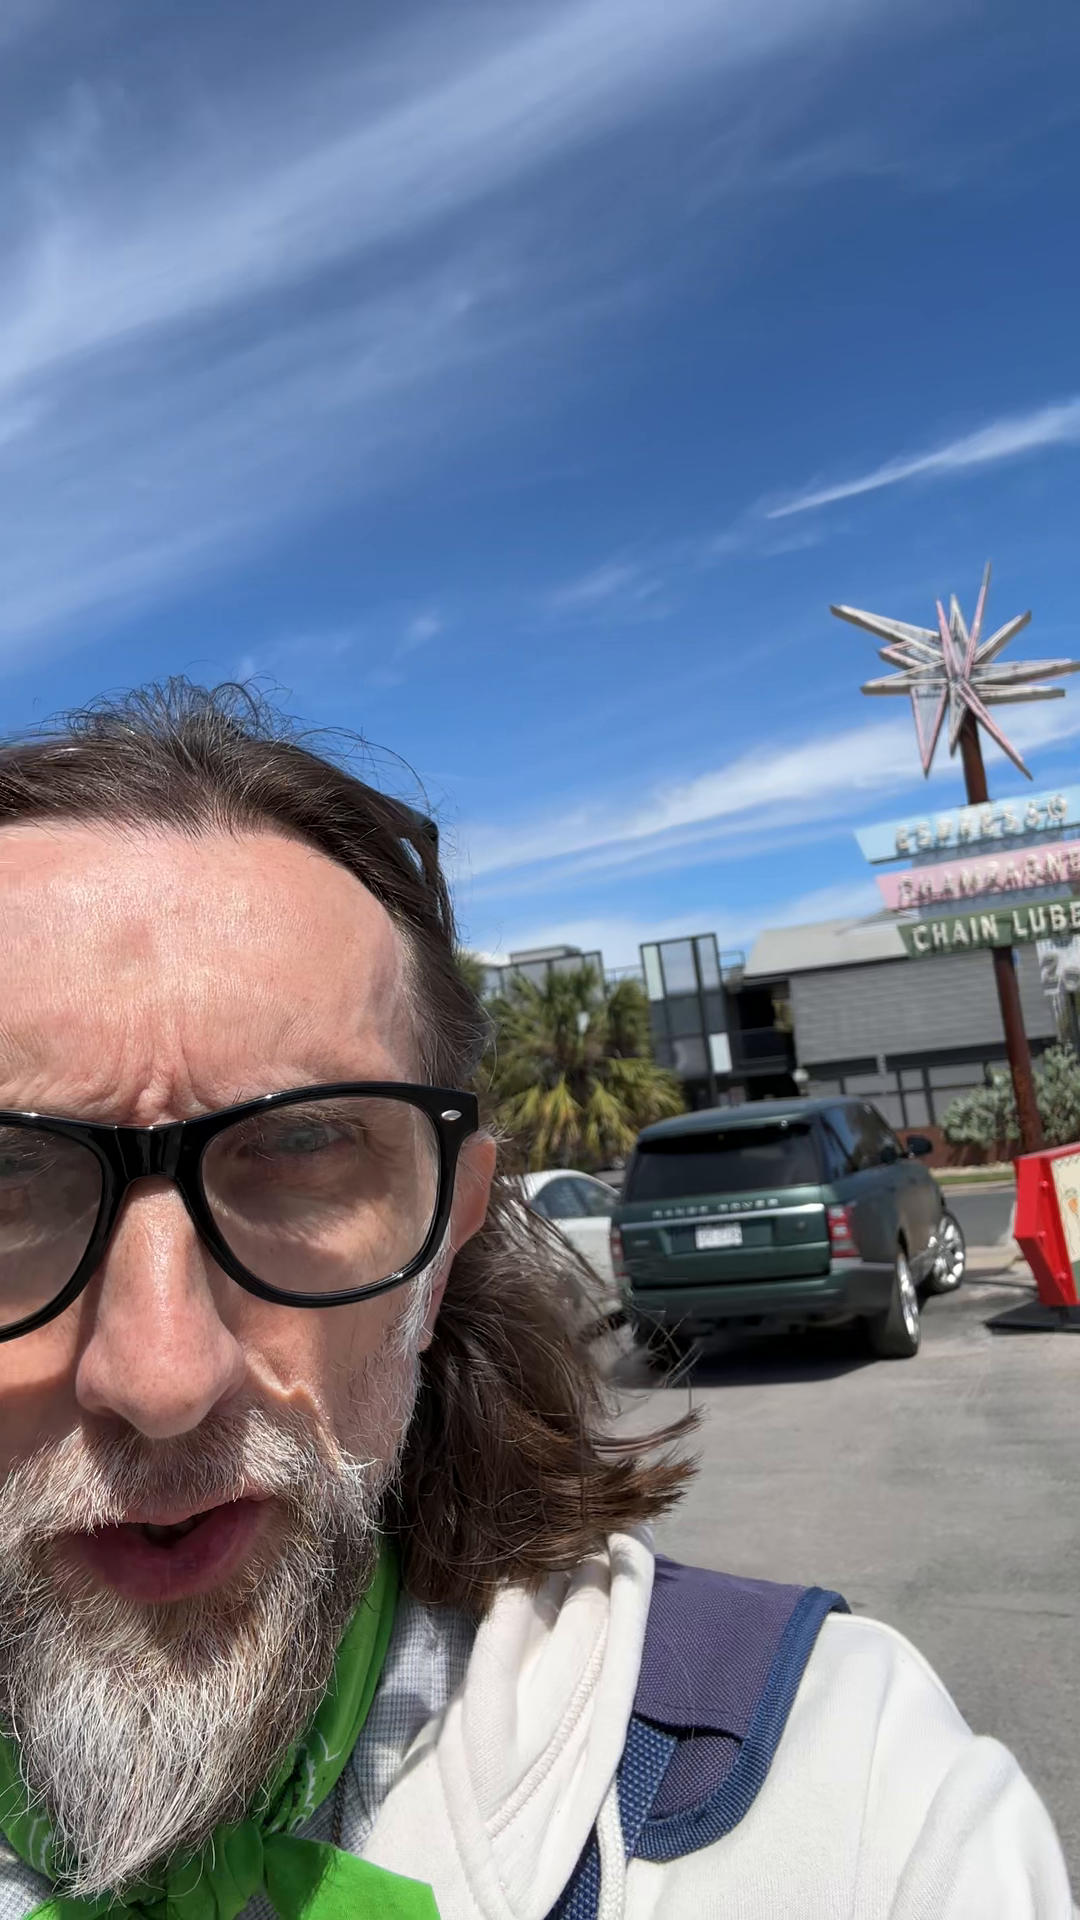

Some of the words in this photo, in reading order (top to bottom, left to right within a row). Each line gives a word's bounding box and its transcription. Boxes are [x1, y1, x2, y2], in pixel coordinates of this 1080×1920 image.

[895, 794, 1068, 850] ESPRESSO
[912, 914, 1000, 952] CHAIN
[1012, 901, 1080, 936] LUBE
[652, 1205, 709, 1219] RANGE
[717, 1198, 779, 1213] ROVER
